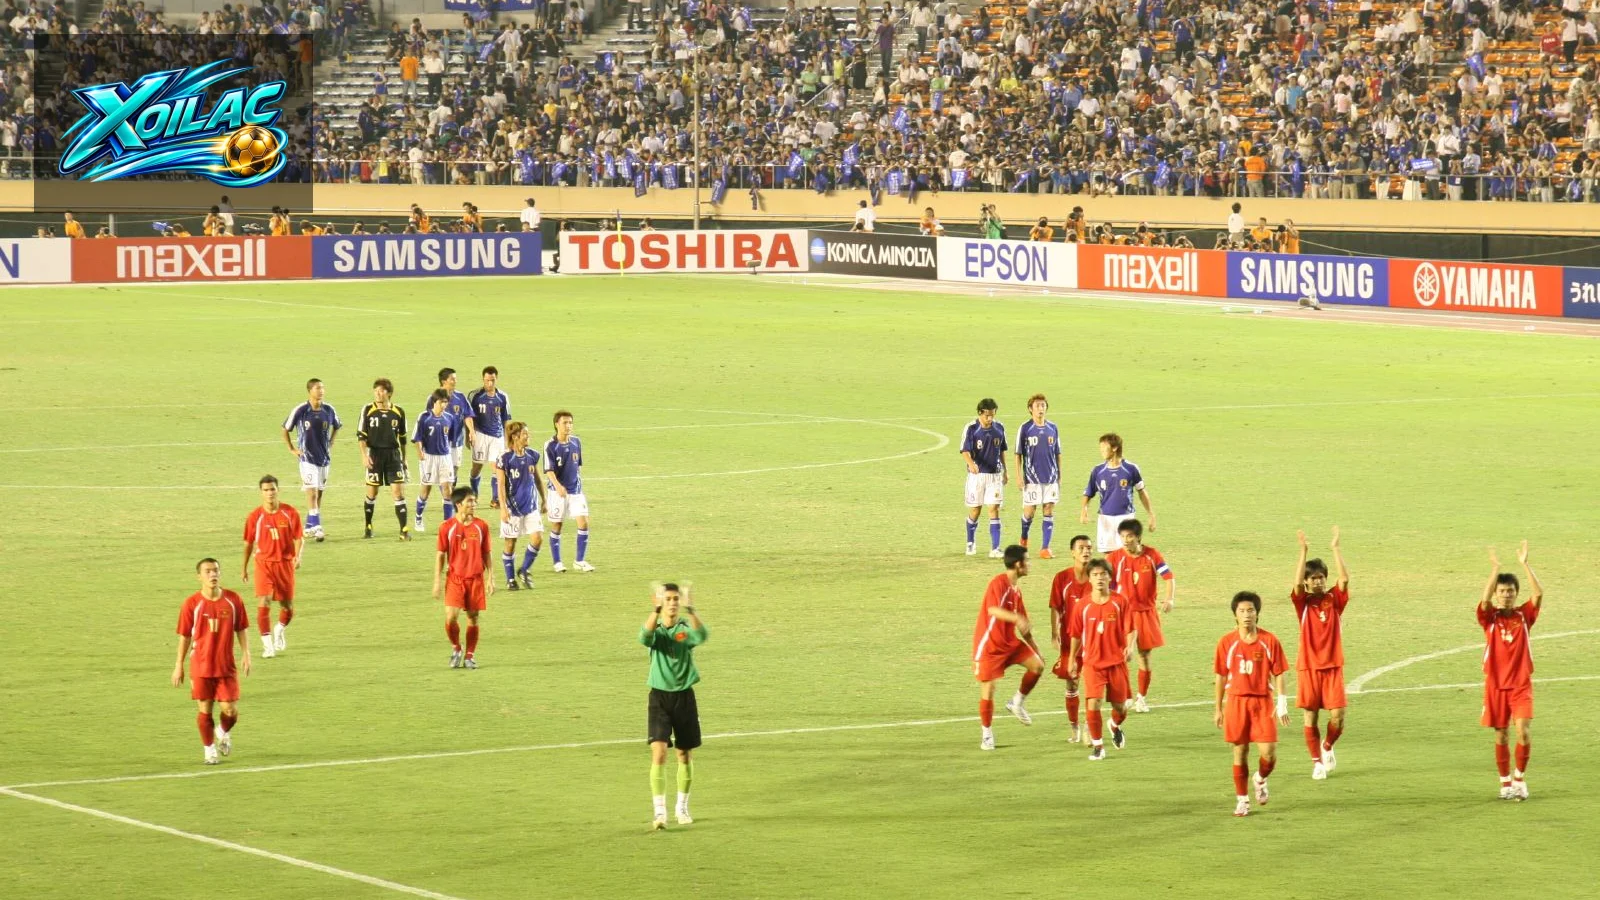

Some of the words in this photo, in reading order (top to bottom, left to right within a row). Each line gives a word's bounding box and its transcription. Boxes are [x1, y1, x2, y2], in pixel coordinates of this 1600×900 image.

[333, 237, 521, 273] SAMSUNG
[568, 233, 799, 270] TOSHIBA
[827, 242, 877, 265] KONICA
[878, 244, 936, 268] MINOLTA
[116, 239, 266, 278] maxell
[965, 242, 1048, 282] EPSON
[1104, 252, 1198, 292] maxell
[1240, 256, 1374, 299] SAMSUNG
[1440, 266, 1537, 310] YAMAHA
[1570, 281, 1600, 304] うれ
[479, 404, 487, 414] 11
[304, 420, 311, 431] 9
[369, 417, 379, 427] 21
[428, 426, 435, 436] 7
[977, 439, 983, 450] 8
[1028, 436, 1038, 446] 10
[556, 456, 562, 467] 2
[368, 472, 379, 483] 21
[426, 473, 432, 482] 7
[509, 468, 520, 480] 16
[1027, 491, 1037, 501] 10
[553, 508, 560, 517] 2
[1096, 621, 1104, 634] 4
[1239, 659, 1254, 675] 20
